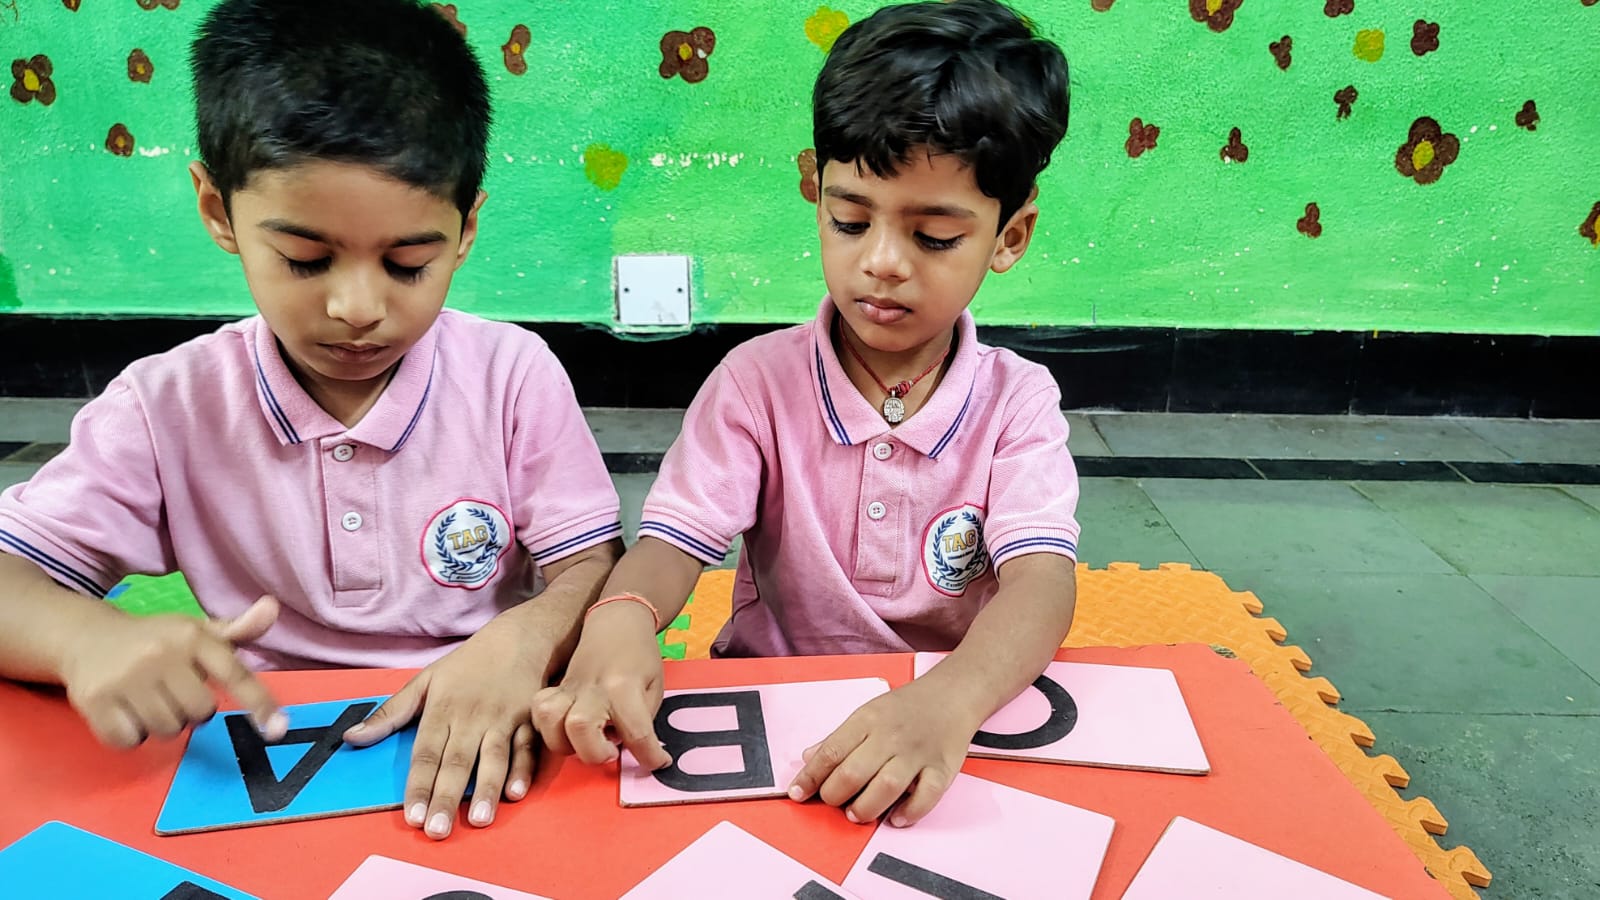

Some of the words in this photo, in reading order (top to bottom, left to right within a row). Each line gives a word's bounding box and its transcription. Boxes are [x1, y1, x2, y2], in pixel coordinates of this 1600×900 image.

[447, 526, 488, 550] TAG
[942, 529, 977, 552] TAG
[224, 701, 377, 813] A
[653, 690, 775, 792] B
